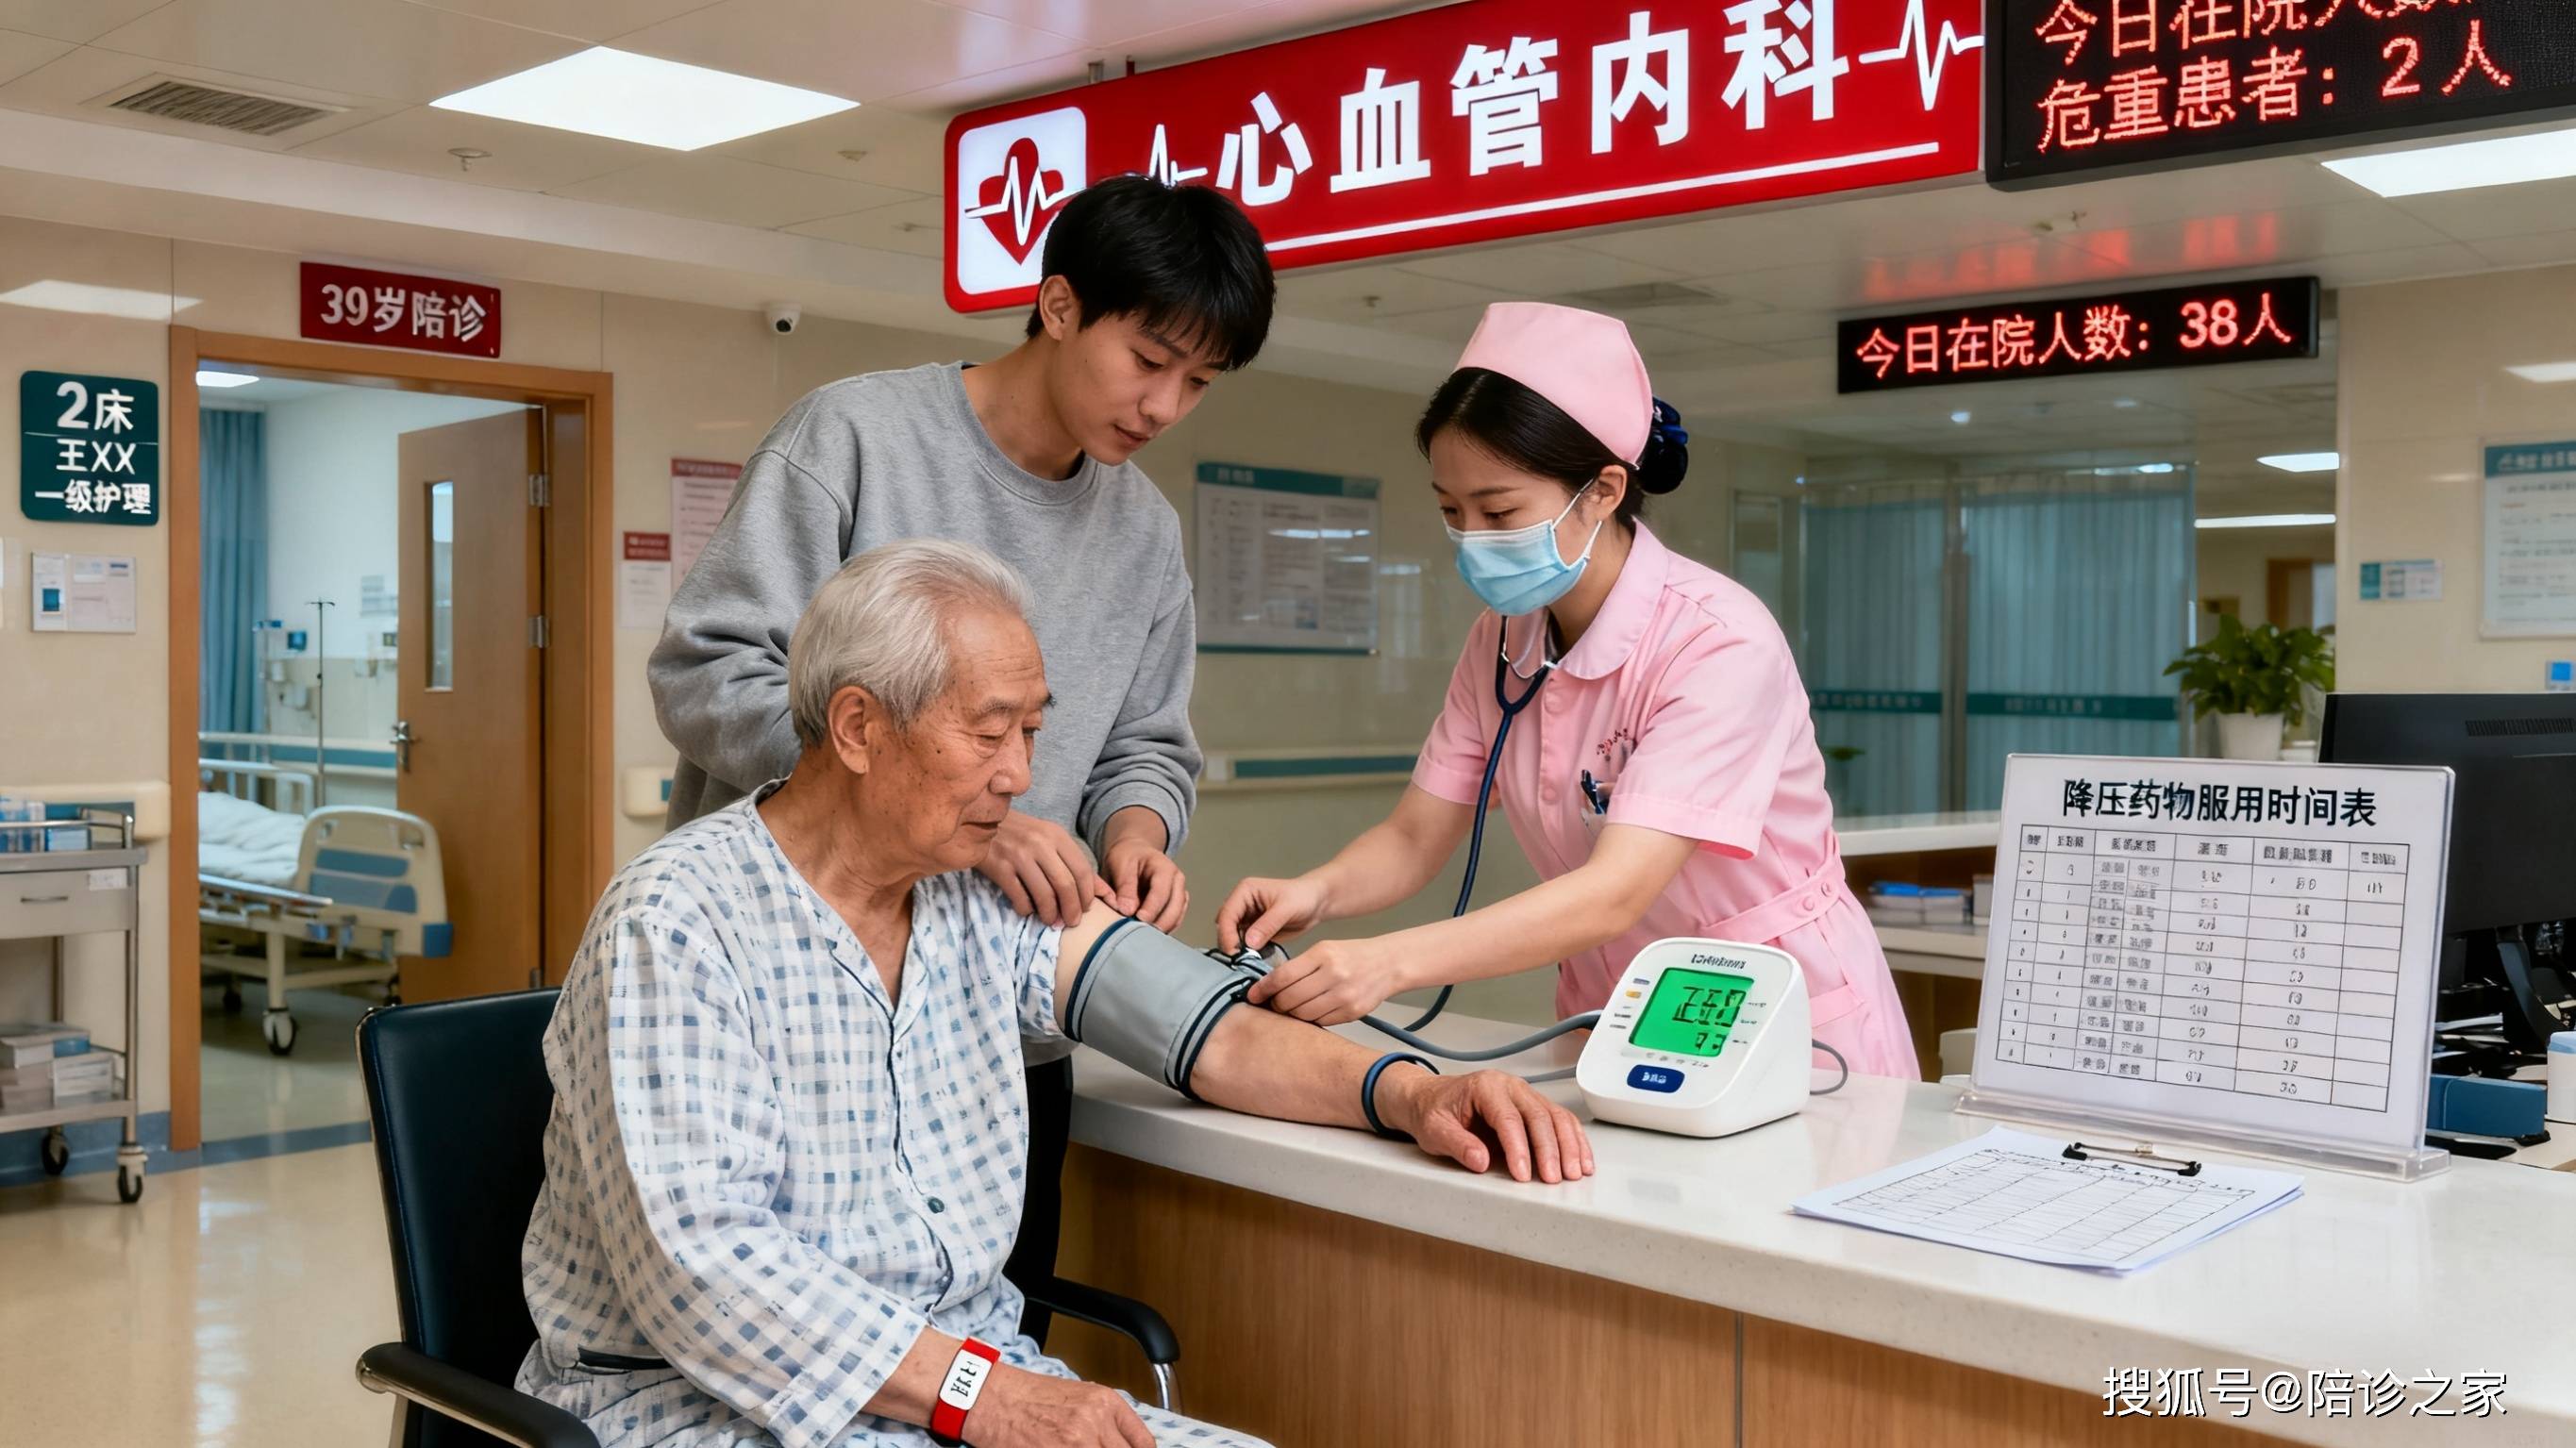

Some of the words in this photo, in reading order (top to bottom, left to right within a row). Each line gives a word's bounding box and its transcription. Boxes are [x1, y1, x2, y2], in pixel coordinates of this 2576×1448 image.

[1216, 0, 1850, 207] 心血管内科
[321, 283, 487, 342] 39岁陪诊
[57, 381, 134, 434] 2床
[56, 439, 137, 474] 王XX
[35, 478, 152, 515] 一级护理
[2063, 778, 2378, 828] 降压药物服用时间表
